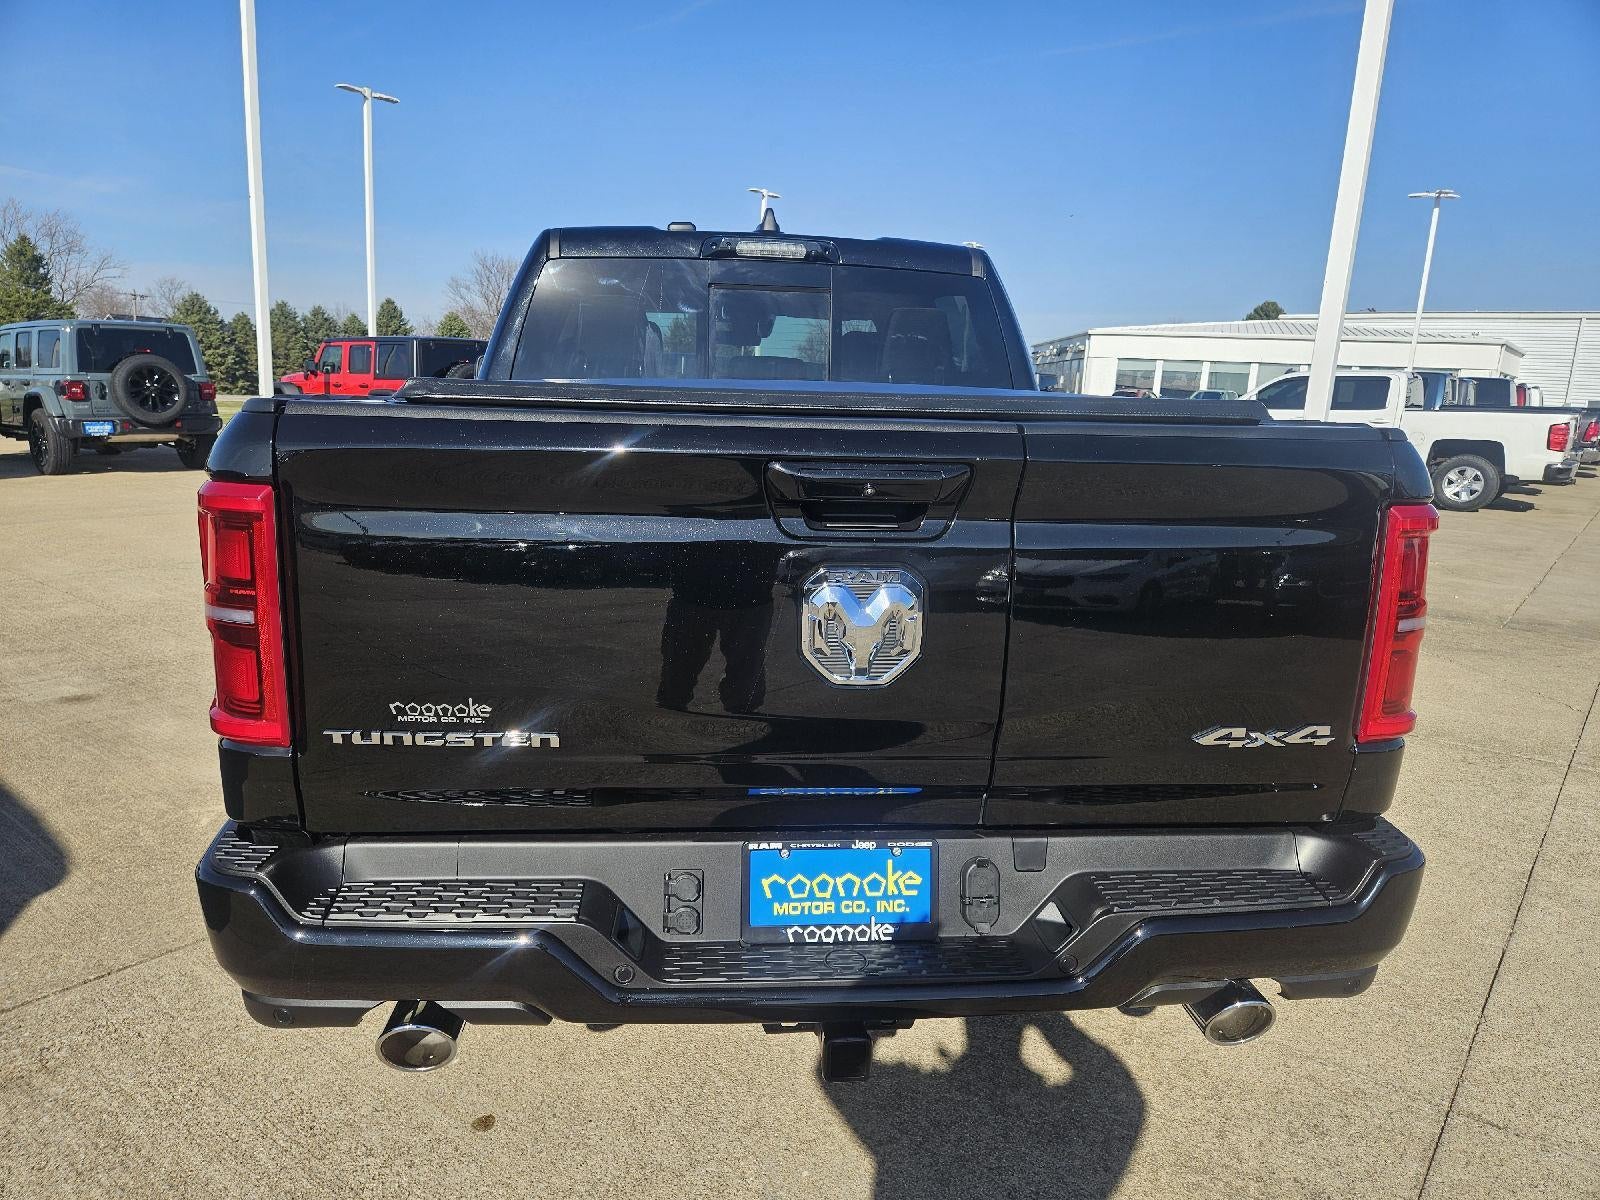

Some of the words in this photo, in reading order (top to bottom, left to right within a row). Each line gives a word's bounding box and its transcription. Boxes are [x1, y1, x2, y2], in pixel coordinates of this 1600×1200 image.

[397, 715, 438, 723] MOTOR
[323, 729, 560, 748] TUNGSTEN
[749, 842, 783, 850] RAM
[851, 839, 877, 851] Jeep
[773, 902, 835, 916] MOTOR
[841, 901, 870, 914] CO.
[876, 899, 910, 913] INC.
